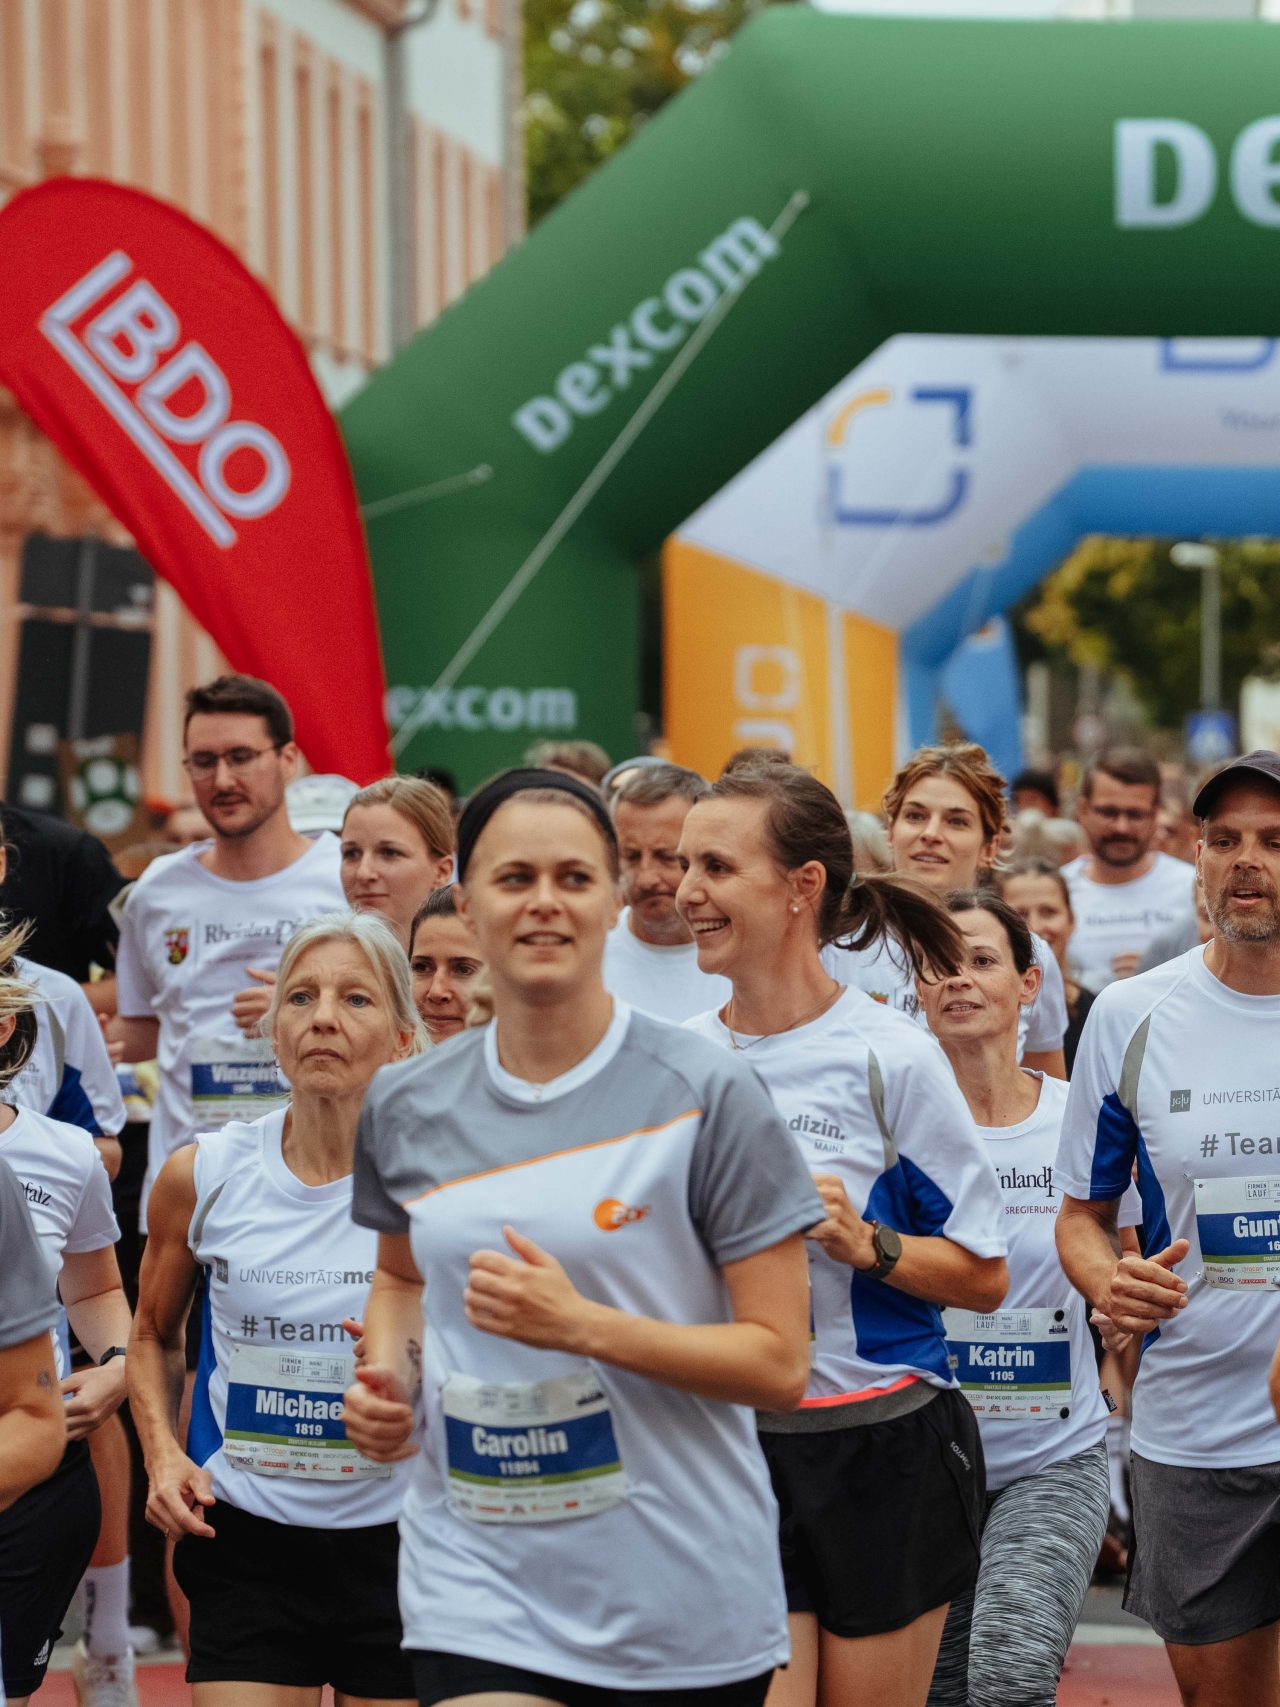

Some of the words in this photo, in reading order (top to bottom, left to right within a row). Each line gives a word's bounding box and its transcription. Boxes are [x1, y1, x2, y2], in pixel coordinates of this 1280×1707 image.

[511, 215, 781, 455] Dexcom
[84, 279, 291, 518] BDO
[1248, 1189, 1267, 1198] LAUF
[976, 1321, 995, 1329] LAUF
[968, 1345, 1035, 1367] Katrin
[281, 1364, 301, 1374] LAUF
[989, 1371, 1015, 1381] 1105
[295, 1422, 323, 1436] 1819
[471, 1426, 569, 1458] Carolin
